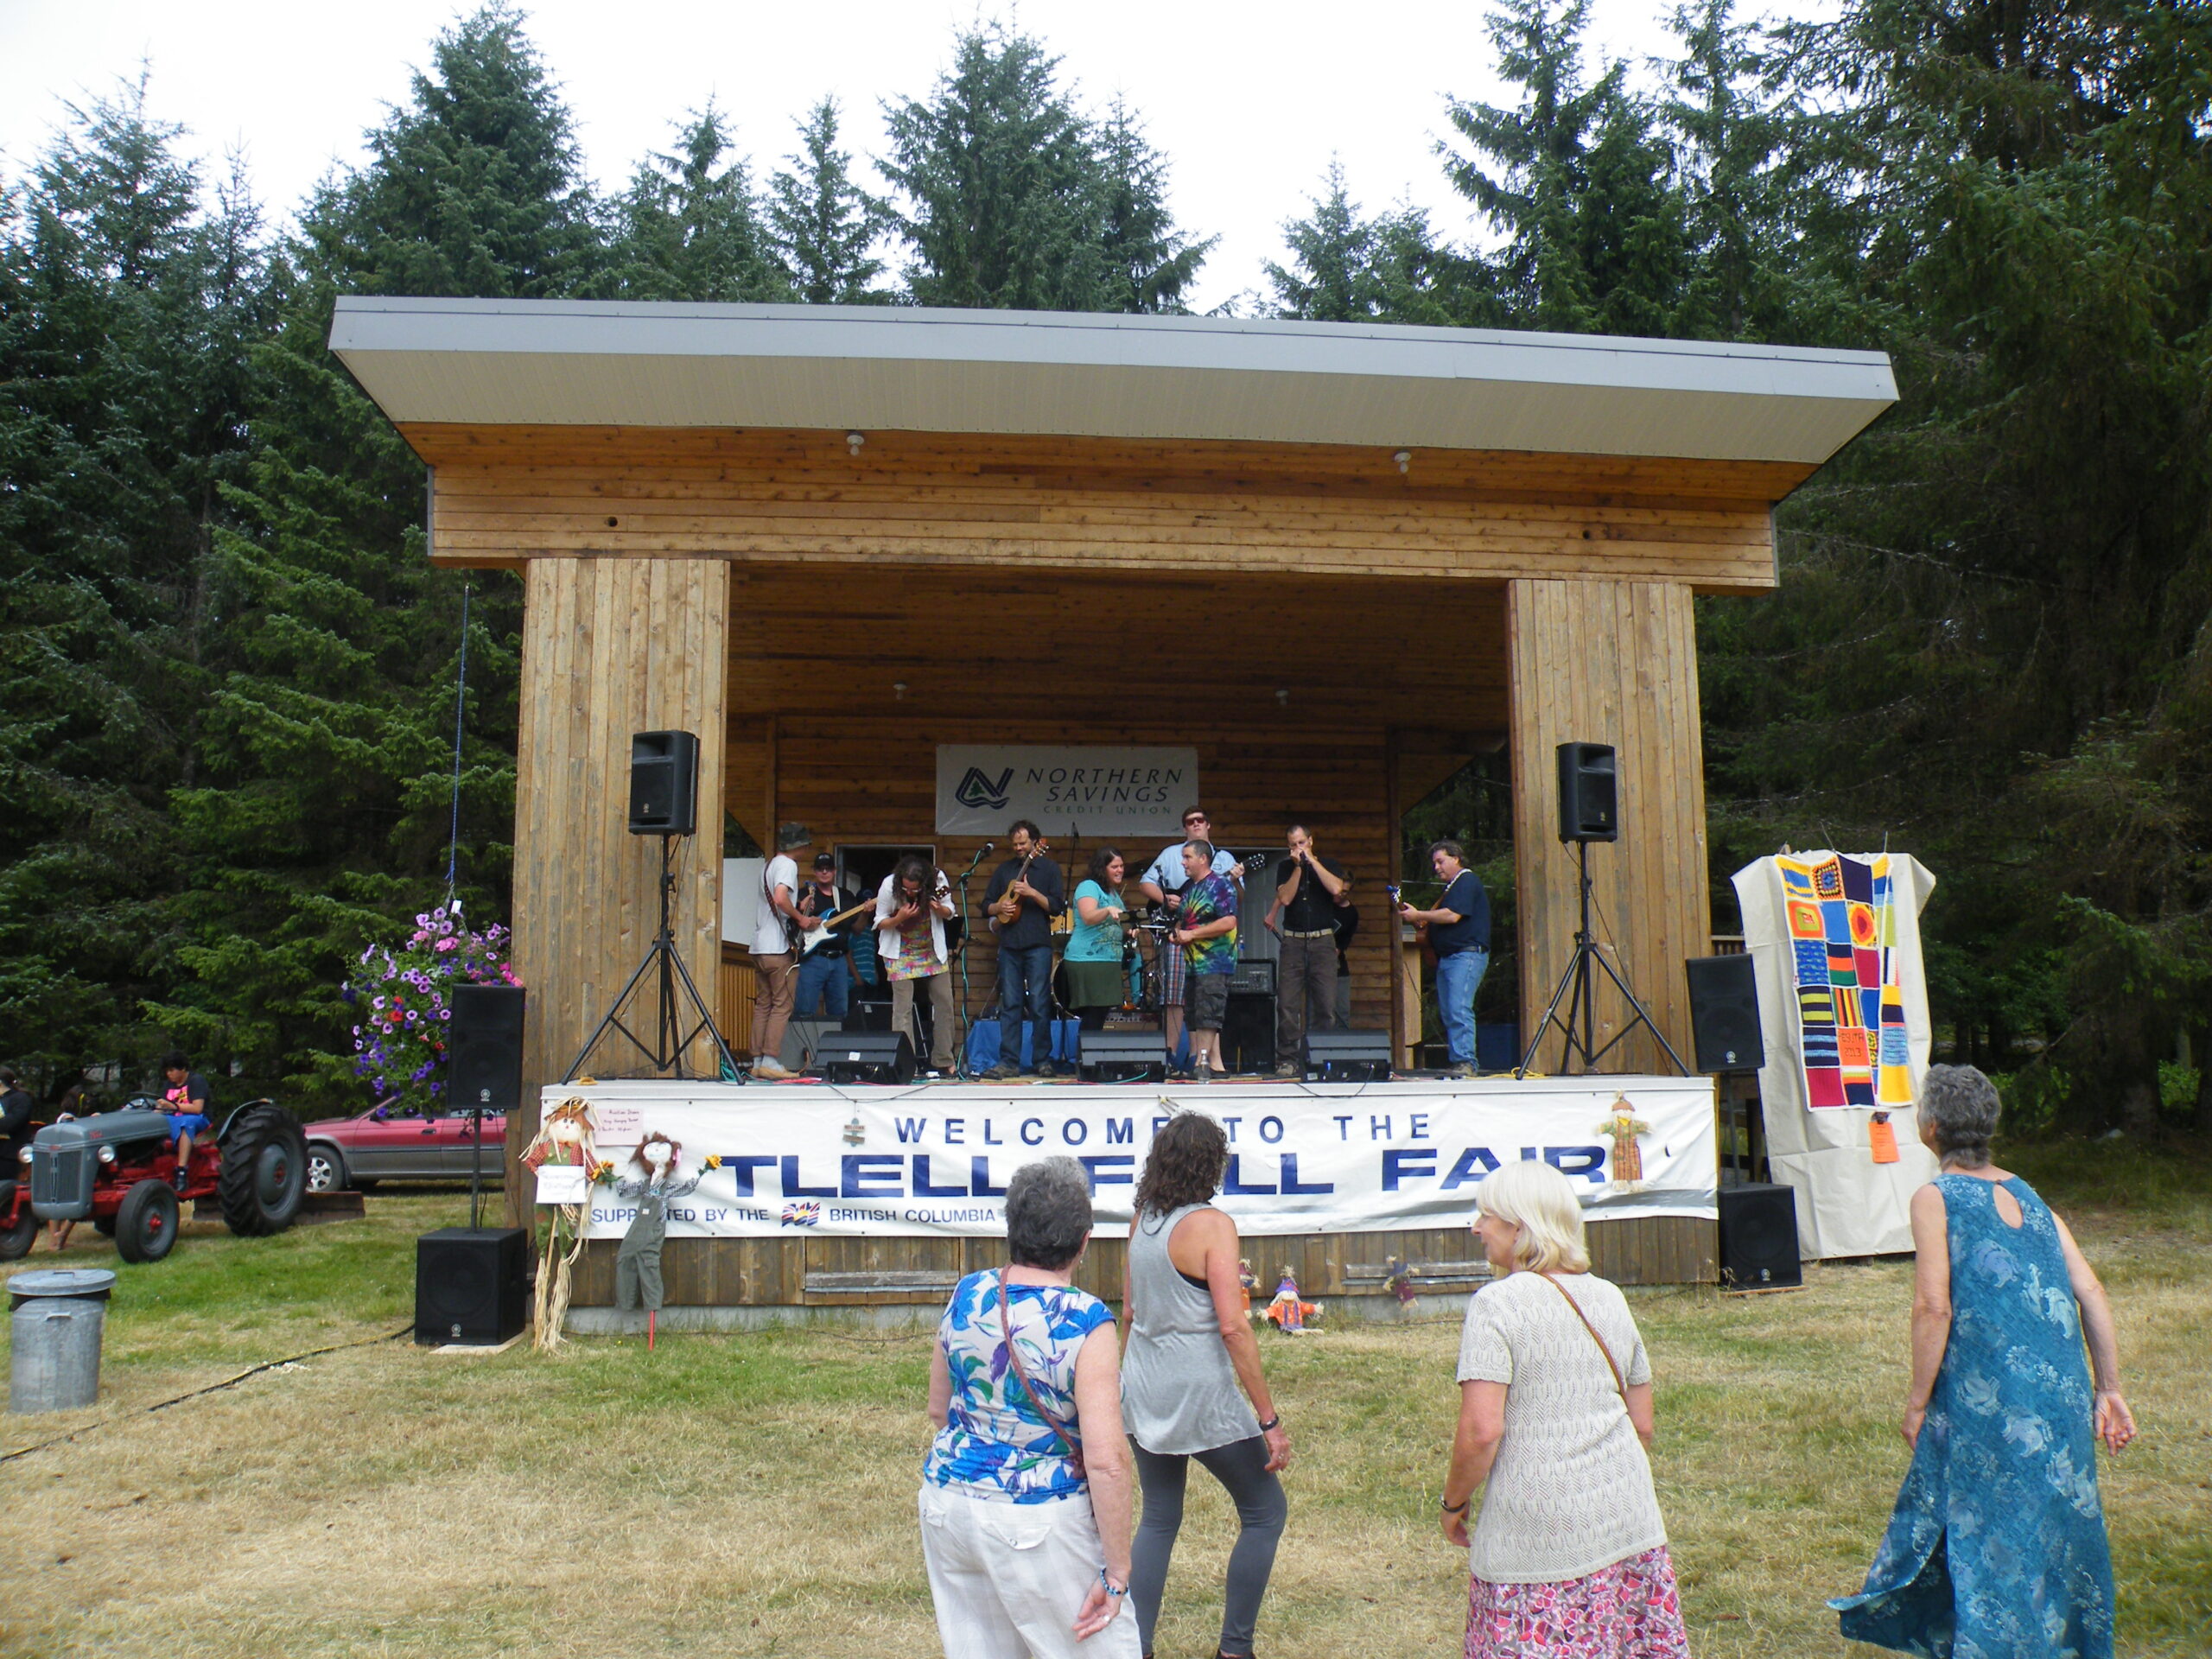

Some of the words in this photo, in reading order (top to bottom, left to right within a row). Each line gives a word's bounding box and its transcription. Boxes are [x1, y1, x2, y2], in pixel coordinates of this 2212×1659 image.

[1026, 768, 1183, 784] NORTHERN
[1046, 786, 1169, 802] SAVINGS
[1043, 805, 1104, 815] CREDIT
[1116, 806, 1173, 815] UNION
[1223, 1116, 1284, 1143] TO
[1332, 1113, 1431, 1141] THE
[720, 1154, 1010, 1198] TLELL
[1077, 1153, 1334, 1198] FLL
[591, 1208, 696, 1223] SUPPTED
[705, 1208, 728, 1222] BY
[736, 1208, 770, 1221] THE
[830, 1208, 897, 1222] BRITISH
[905, 1208, 996, 1223] COLUMBIA
